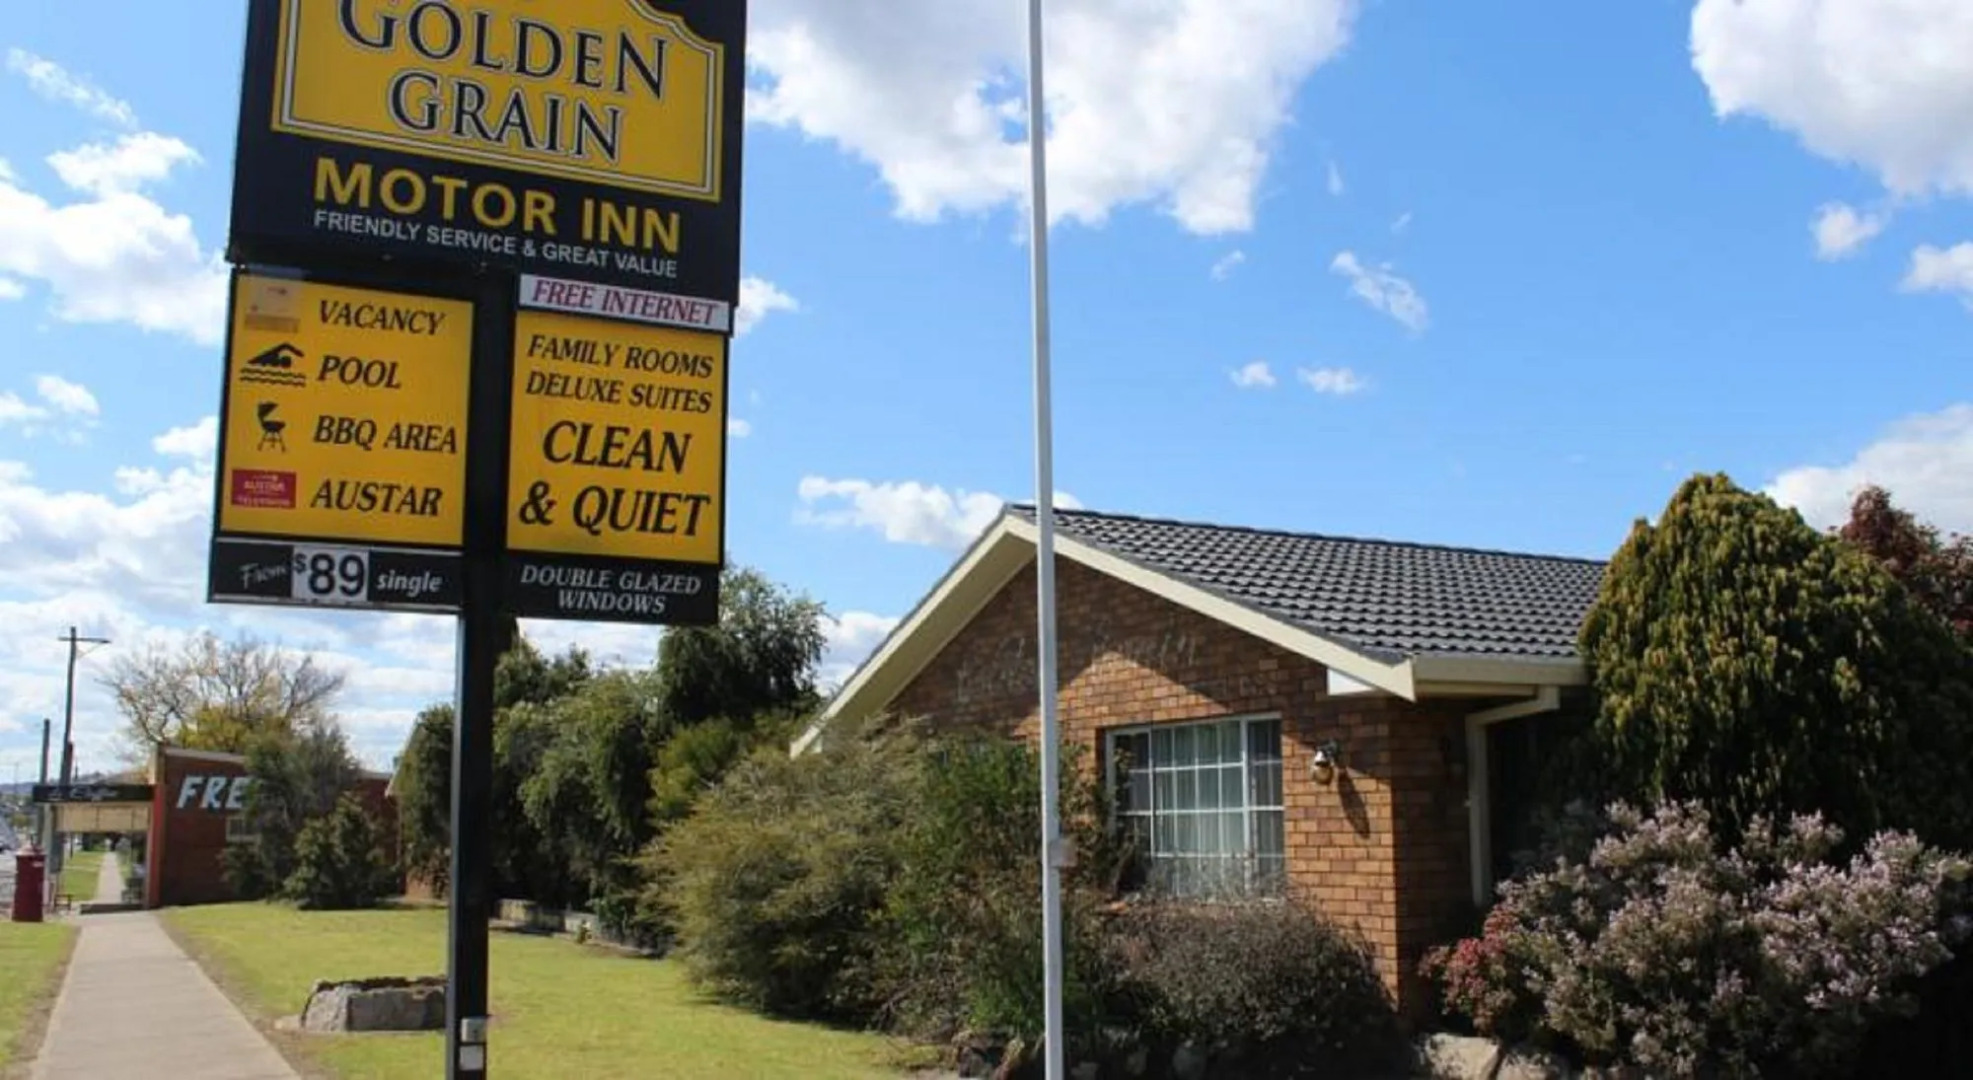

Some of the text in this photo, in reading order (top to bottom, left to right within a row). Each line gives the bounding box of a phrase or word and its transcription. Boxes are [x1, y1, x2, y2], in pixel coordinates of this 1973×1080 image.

[338, 0, 669, 99] GOLDEN
[391, 72, 622, 162] GRAIN
[313, 157, 682, 254] MOTOR INN
[313, 209, 678, 278] FRIENDLY SERVICE & GREAT VALUE
[319, 299, 447, 336] VACANCY
[533, 279, 717, 325] FREE INTERNET
[317, 354, 402, 389] POOL
[527, 334, 714, 378] FAMILY ROOMS
[525, 371, 713, 414] DELUXE SUITES
[313, 415, 458, 454] BBQ AREA
[542, 420, 692, 475] CLEAN
[310, 479, 444, 516] AUSTAR
[518, 480, 712, 536] & QUIET
[294, 552, 365, 597] $89
[377, 570, 443, 598] single
[520, 564, 701, 594] DOUBLE GLAZED
[557, 589, 666, 615] WINDOWS
